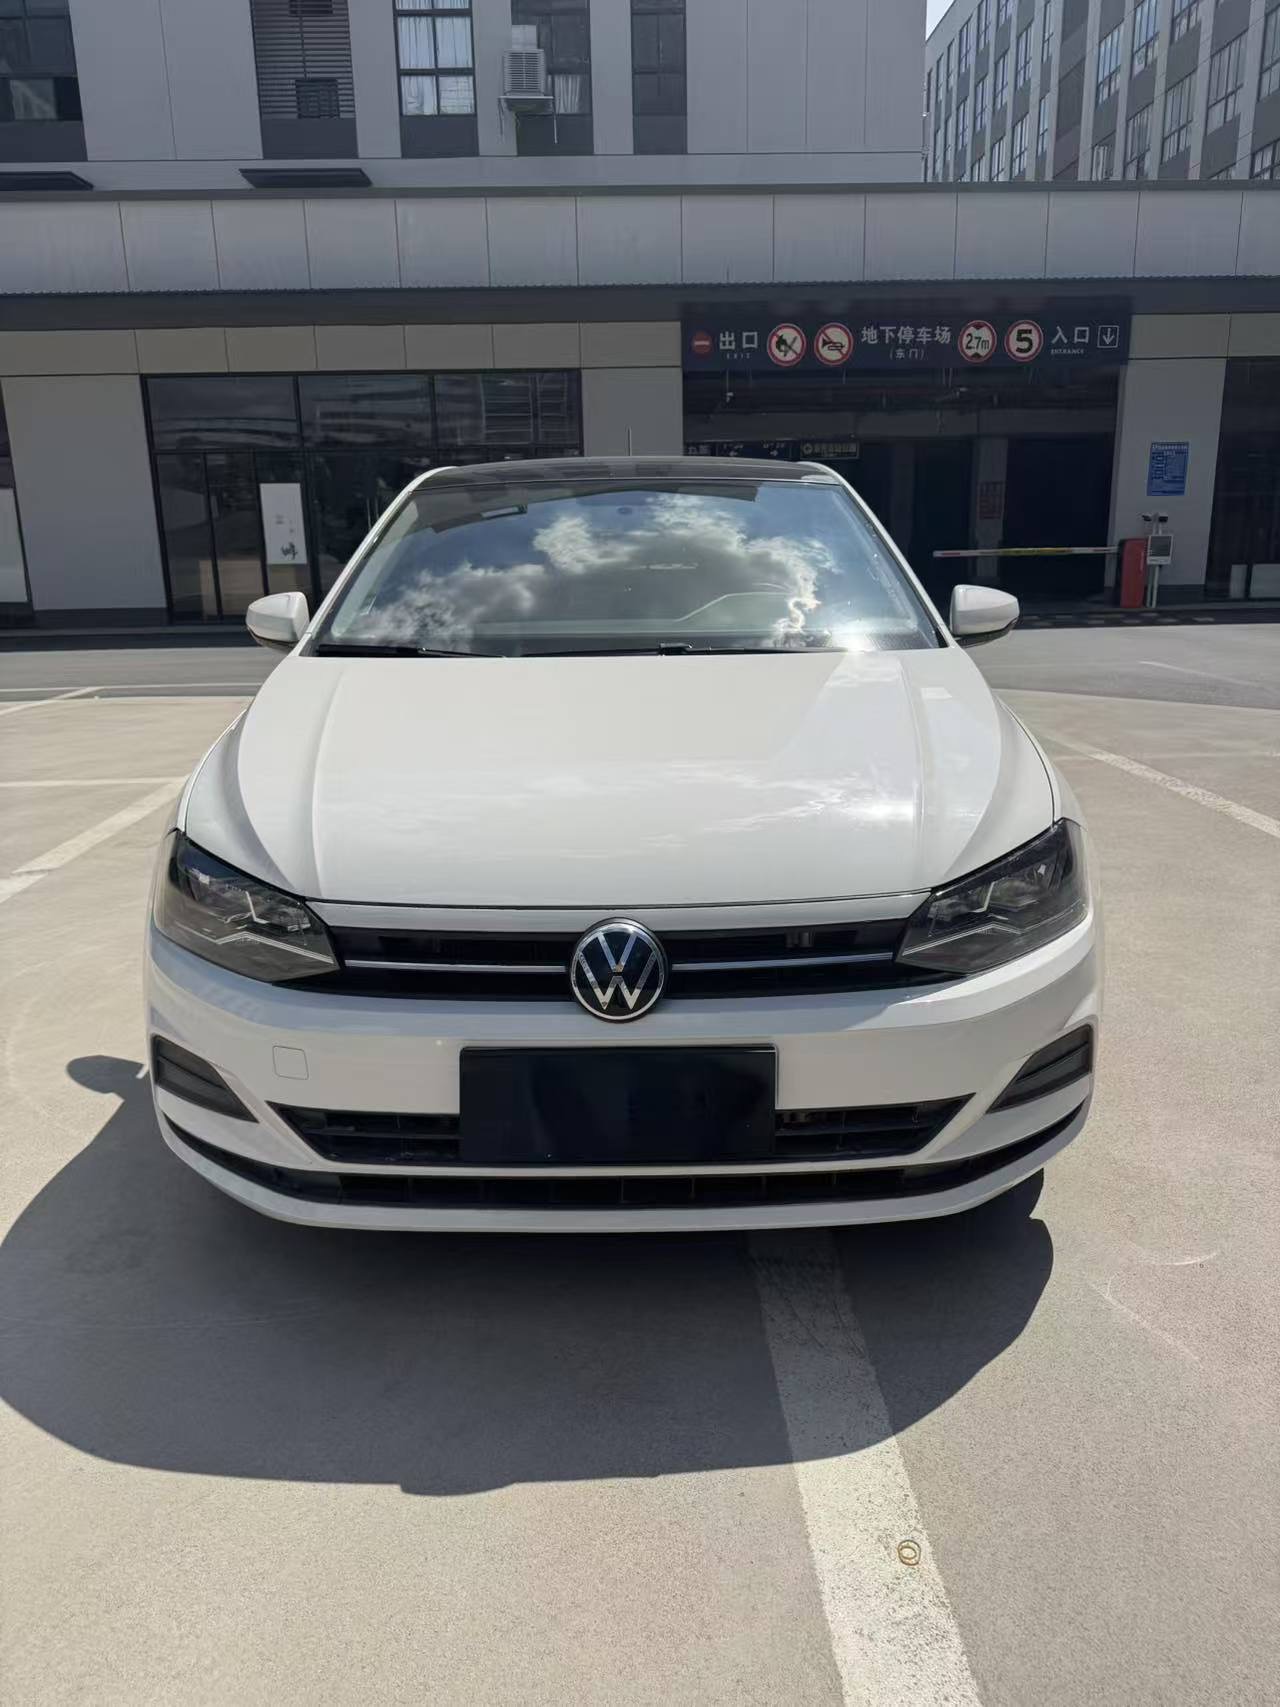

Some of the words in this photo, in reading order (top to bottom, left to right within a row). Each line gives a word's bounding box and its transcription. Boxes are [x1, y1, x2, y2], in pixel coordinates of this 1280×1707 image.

[719, 331, 758, 350] 出口
[861, 325, 952, 345] 地下停车场
[1016, 328, 1034, 354] 5
[1051, 326, 1090, 344] 入口
